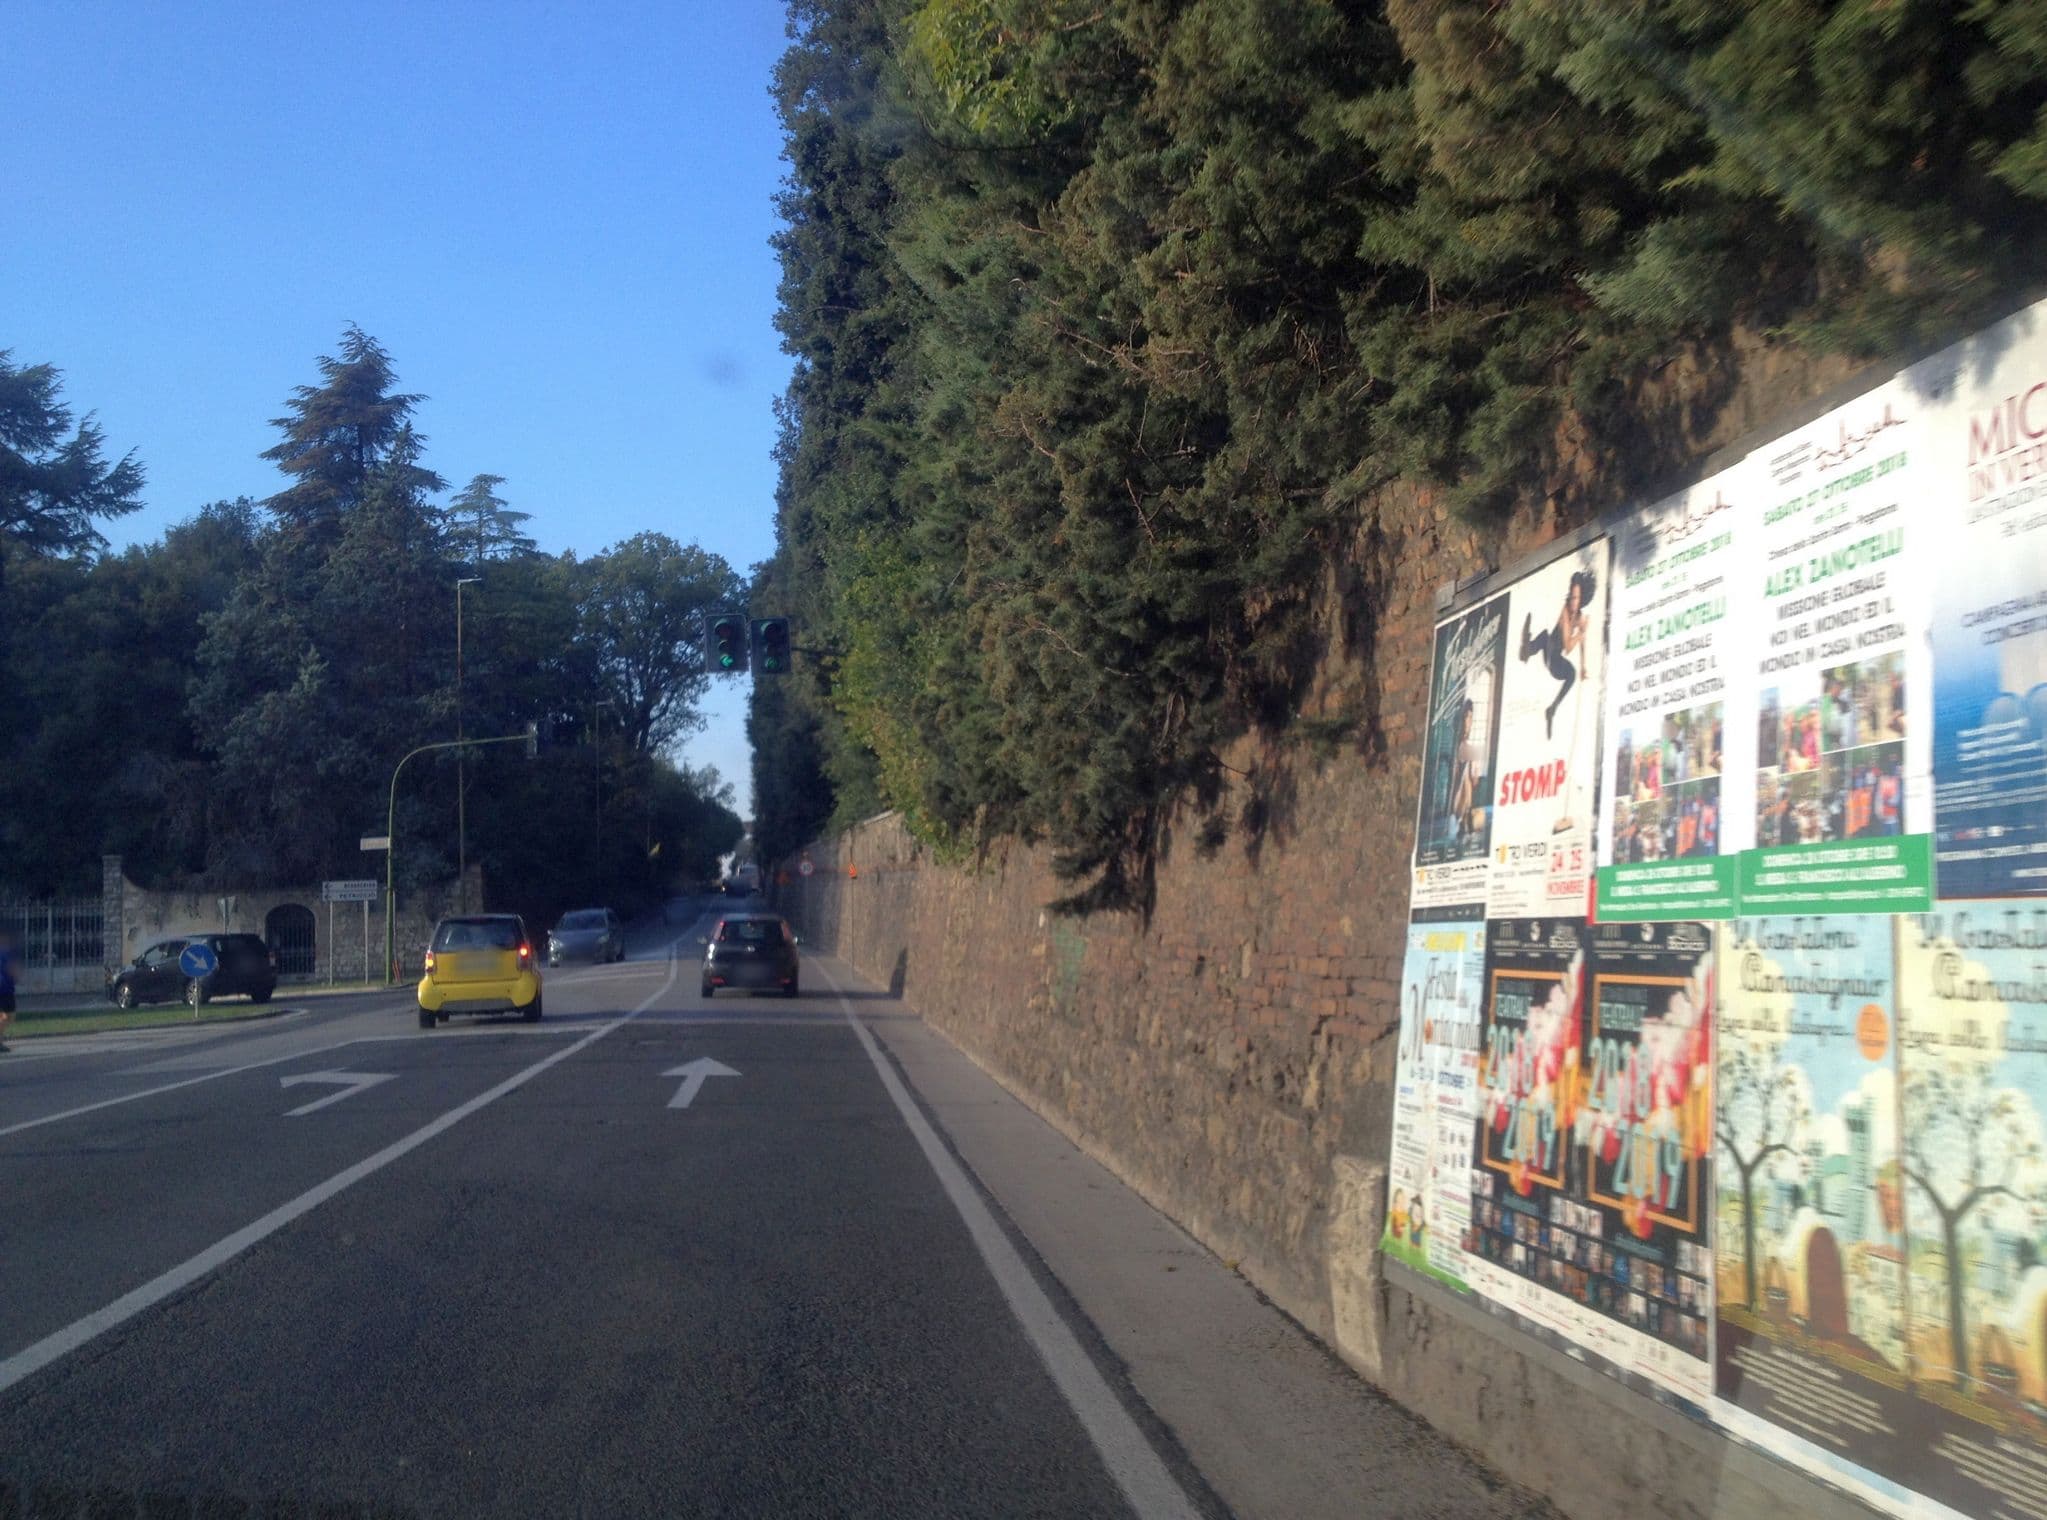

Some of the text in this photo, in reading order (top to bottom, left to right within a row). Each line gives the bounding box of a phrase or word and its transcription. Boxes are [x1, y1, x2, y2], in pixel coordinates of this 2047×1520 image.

[1966, 379, 2047, 467] MIC
[1823, 464, 1875, 500] OTTOBRE
[1763, 563, 1805, 600] ALEX
[1808, 527, 1905, 584] ZANOTELLI
[1776, 570, 1887, 620] MISSIONE GLOBALE
[1814, 606, 1861, 634] MONDO
[1623, 623, 1653, 651] ALEX
[1656, 595, 1727, 641] ZANOTELLI
[1759, 650, 1801, 675] MONDO
[1820, 637, 1852, 659] CASA
[1855, 621, 1907, 649] NOSTRA
[1660, 661, 1693, 684] MONDO
[1499, 758, 1566, 807] STOMP
[1551, 848, 1583, 872] 24 25
[1546, 879, 1584, 896] NOVEMBRE
[1484, 1023, 1534, 1096] 2018
[1588, 1036, 1652, 1121] 2018
